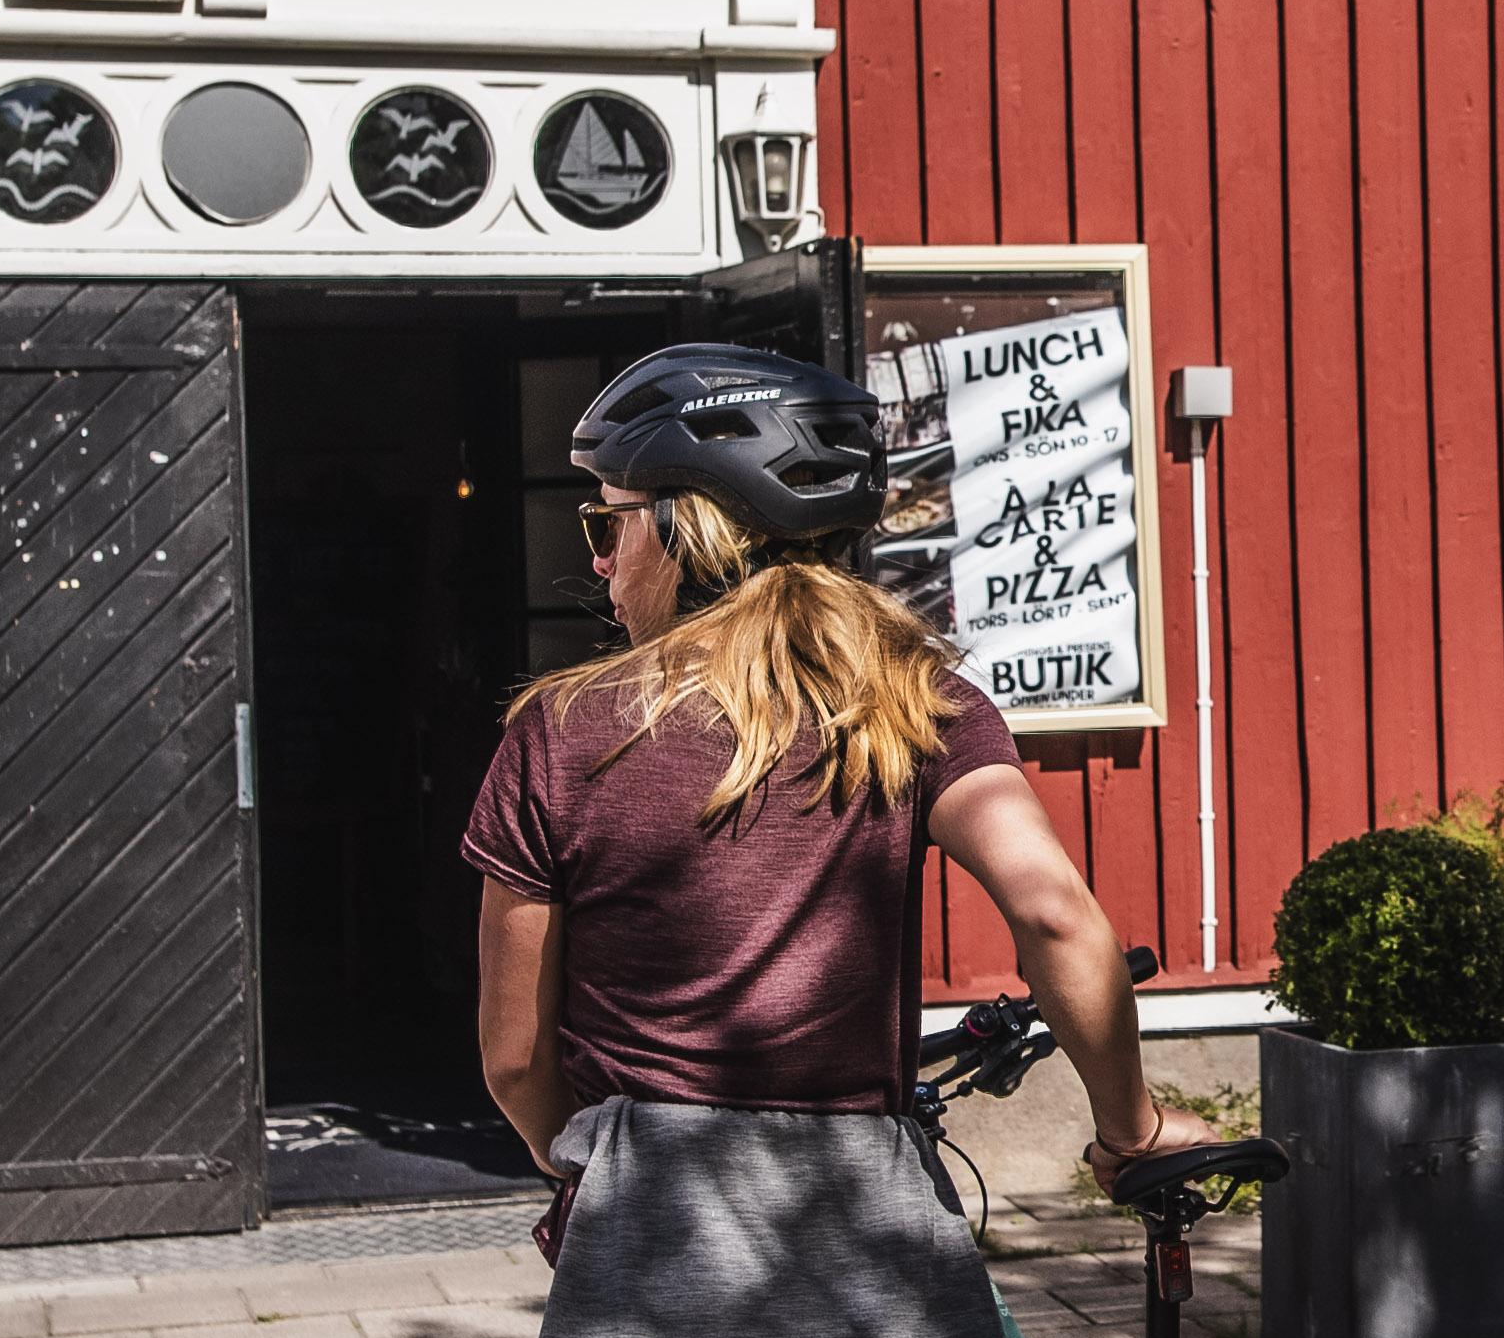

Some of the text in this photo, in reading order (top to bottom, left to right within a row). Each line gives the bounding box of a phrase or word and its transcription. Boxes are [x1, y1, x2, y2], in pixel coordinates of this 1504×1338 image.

[963, 327, 1104, 383] LUNCH
[680, 388, 782, 414] ALLEBIKE
[1029, 373, 1059, 402] &
[1001, 399, 1087, 444] FIKA
[1025, 436, 1066, 459] SÖN
[1071, 435, 1089, 447] 10
[1104, 427, 1119, 443] 17
[1001, 474, 1094, 520] À LA
[974, 493, 1116, 549] CARTE
[1034, 534, 1058, 568] &
[987, 563, 1107, 610] PIZZA
[968, 612, 1009, 633] TORS
[1023, 602, 1056, 625] LÖR
[1059, 604, 1072, 619] 17
[992, 652, 1113, 695] BUTIK
